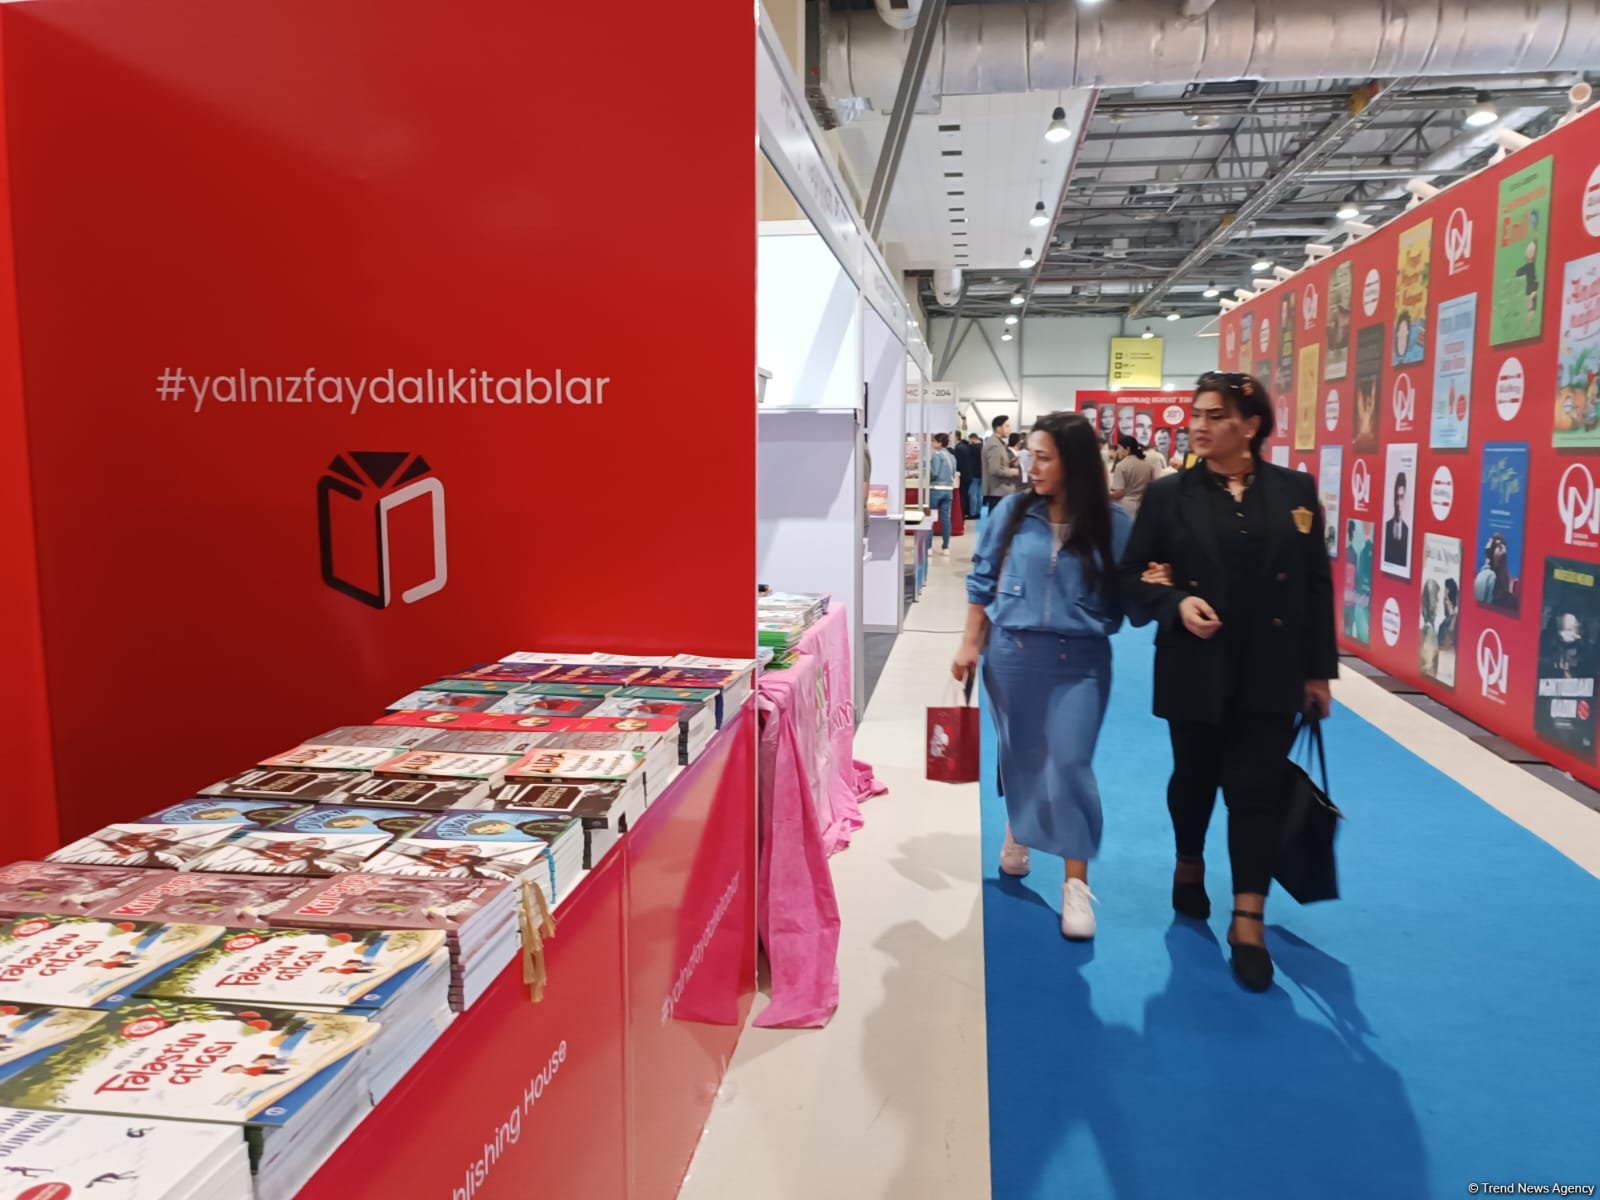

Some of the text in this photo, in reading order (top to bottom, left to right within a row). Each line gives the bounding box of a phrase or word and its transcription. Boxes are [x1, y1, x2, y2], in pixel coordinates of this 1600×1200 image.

[155, 367, 610, 414] #yalnızfaydalıkitablar
[94, 1033, 206, 1095] Fələstin
[168, 1041, 237, 1085] atlası
[523, 1040, 567, 1115] House
